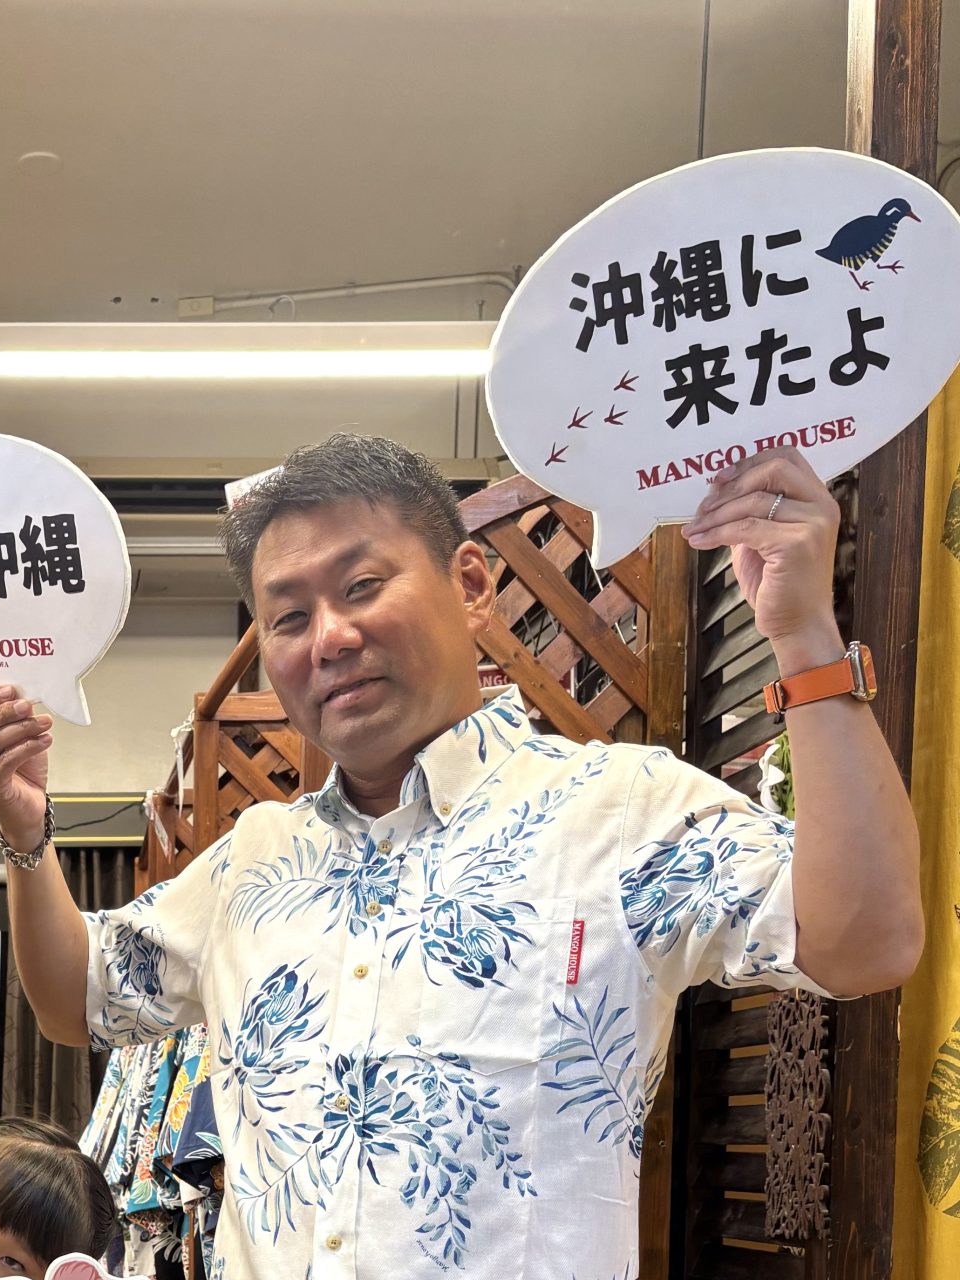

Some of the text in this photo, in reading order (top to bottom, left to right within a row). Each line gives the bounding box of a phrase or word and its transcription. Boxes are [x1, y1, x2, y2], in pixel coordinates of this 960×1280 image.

[568, 228, 809, 352] 沖縄に
[663, 306, 891, 430] 来たよ
[635, 444, 747, 491] MANGO
[567, 922, 582, 982] MANGO HOUSE
